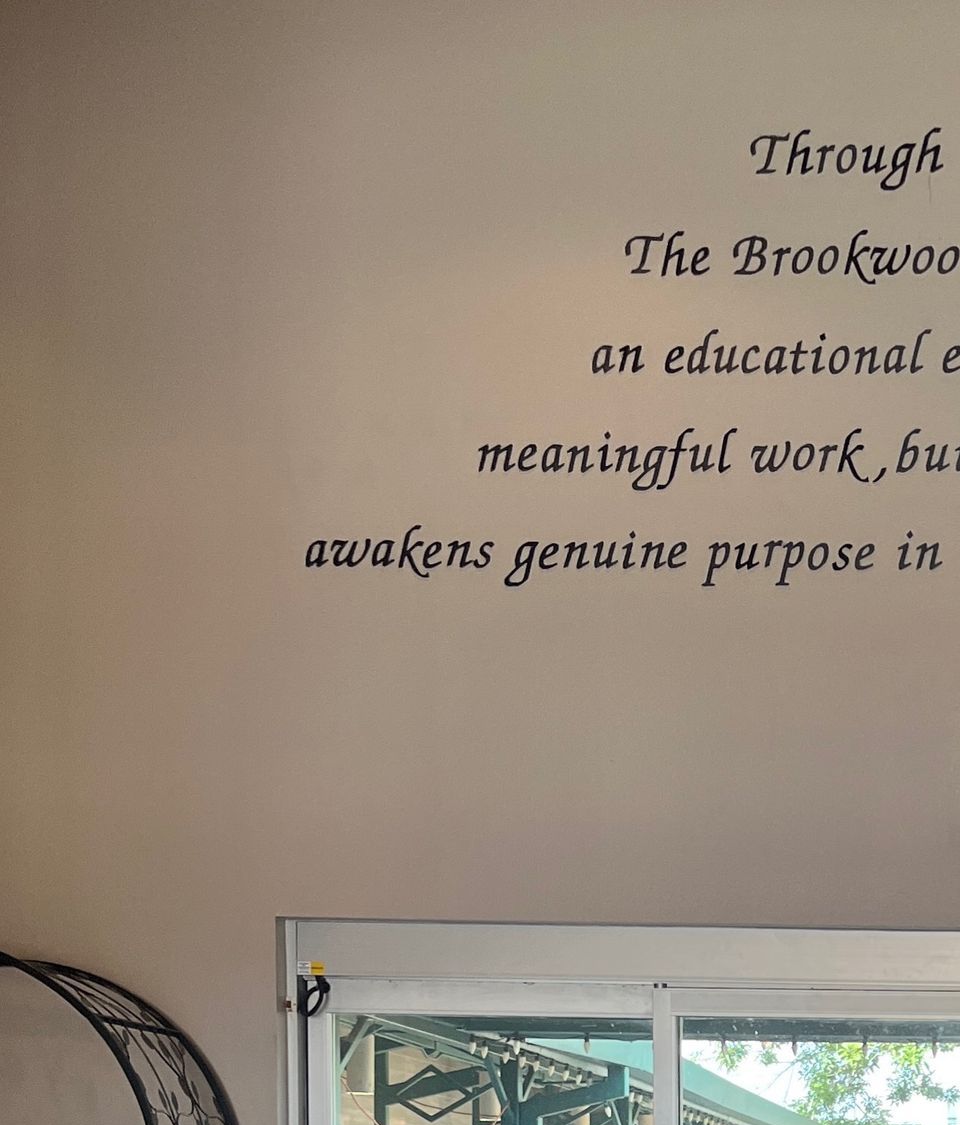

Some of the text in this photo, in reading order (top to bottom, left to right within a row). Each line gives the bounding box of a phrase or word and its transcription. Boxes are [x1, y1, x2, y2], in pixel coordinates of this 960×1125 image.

[749, 126, 945, 192] Through
[624, 230, 711, 278] The
[591, 344, 646, 375] an
[664, 328, 933, 376] educational
[477, 427, 739, 492] meaningful
[304, 524, 496, 579] awakens
[503, 530, 688, 588] genuine
[700, 539, 876, 588] purpose
[897, 529, 944, 571] in
